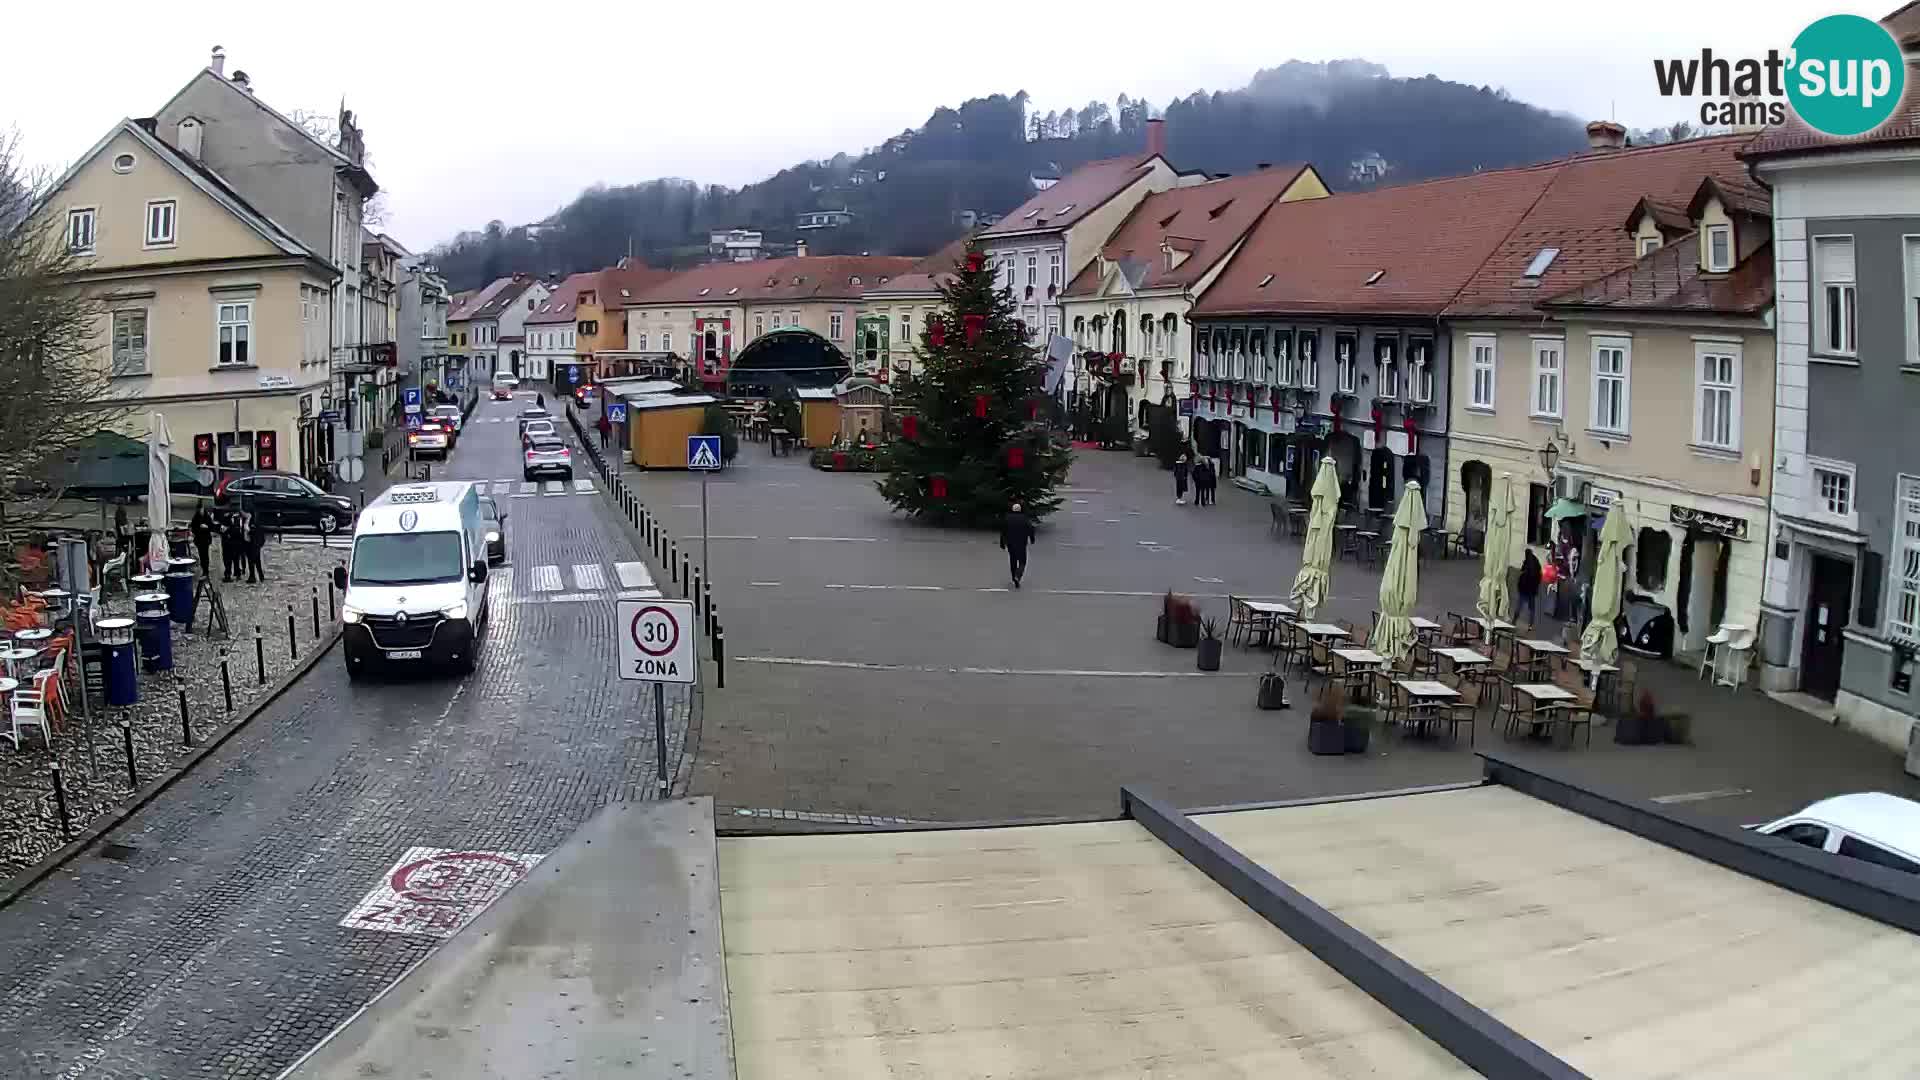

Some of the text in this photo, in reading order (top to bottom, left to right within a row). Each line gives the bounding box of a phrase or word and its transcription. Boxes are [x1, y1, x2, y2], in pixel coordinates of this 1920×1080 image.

[408, 391, 416, 402] P
[644, 621, 668, 643] 30
[633, 658, 679, 676] ZONA
